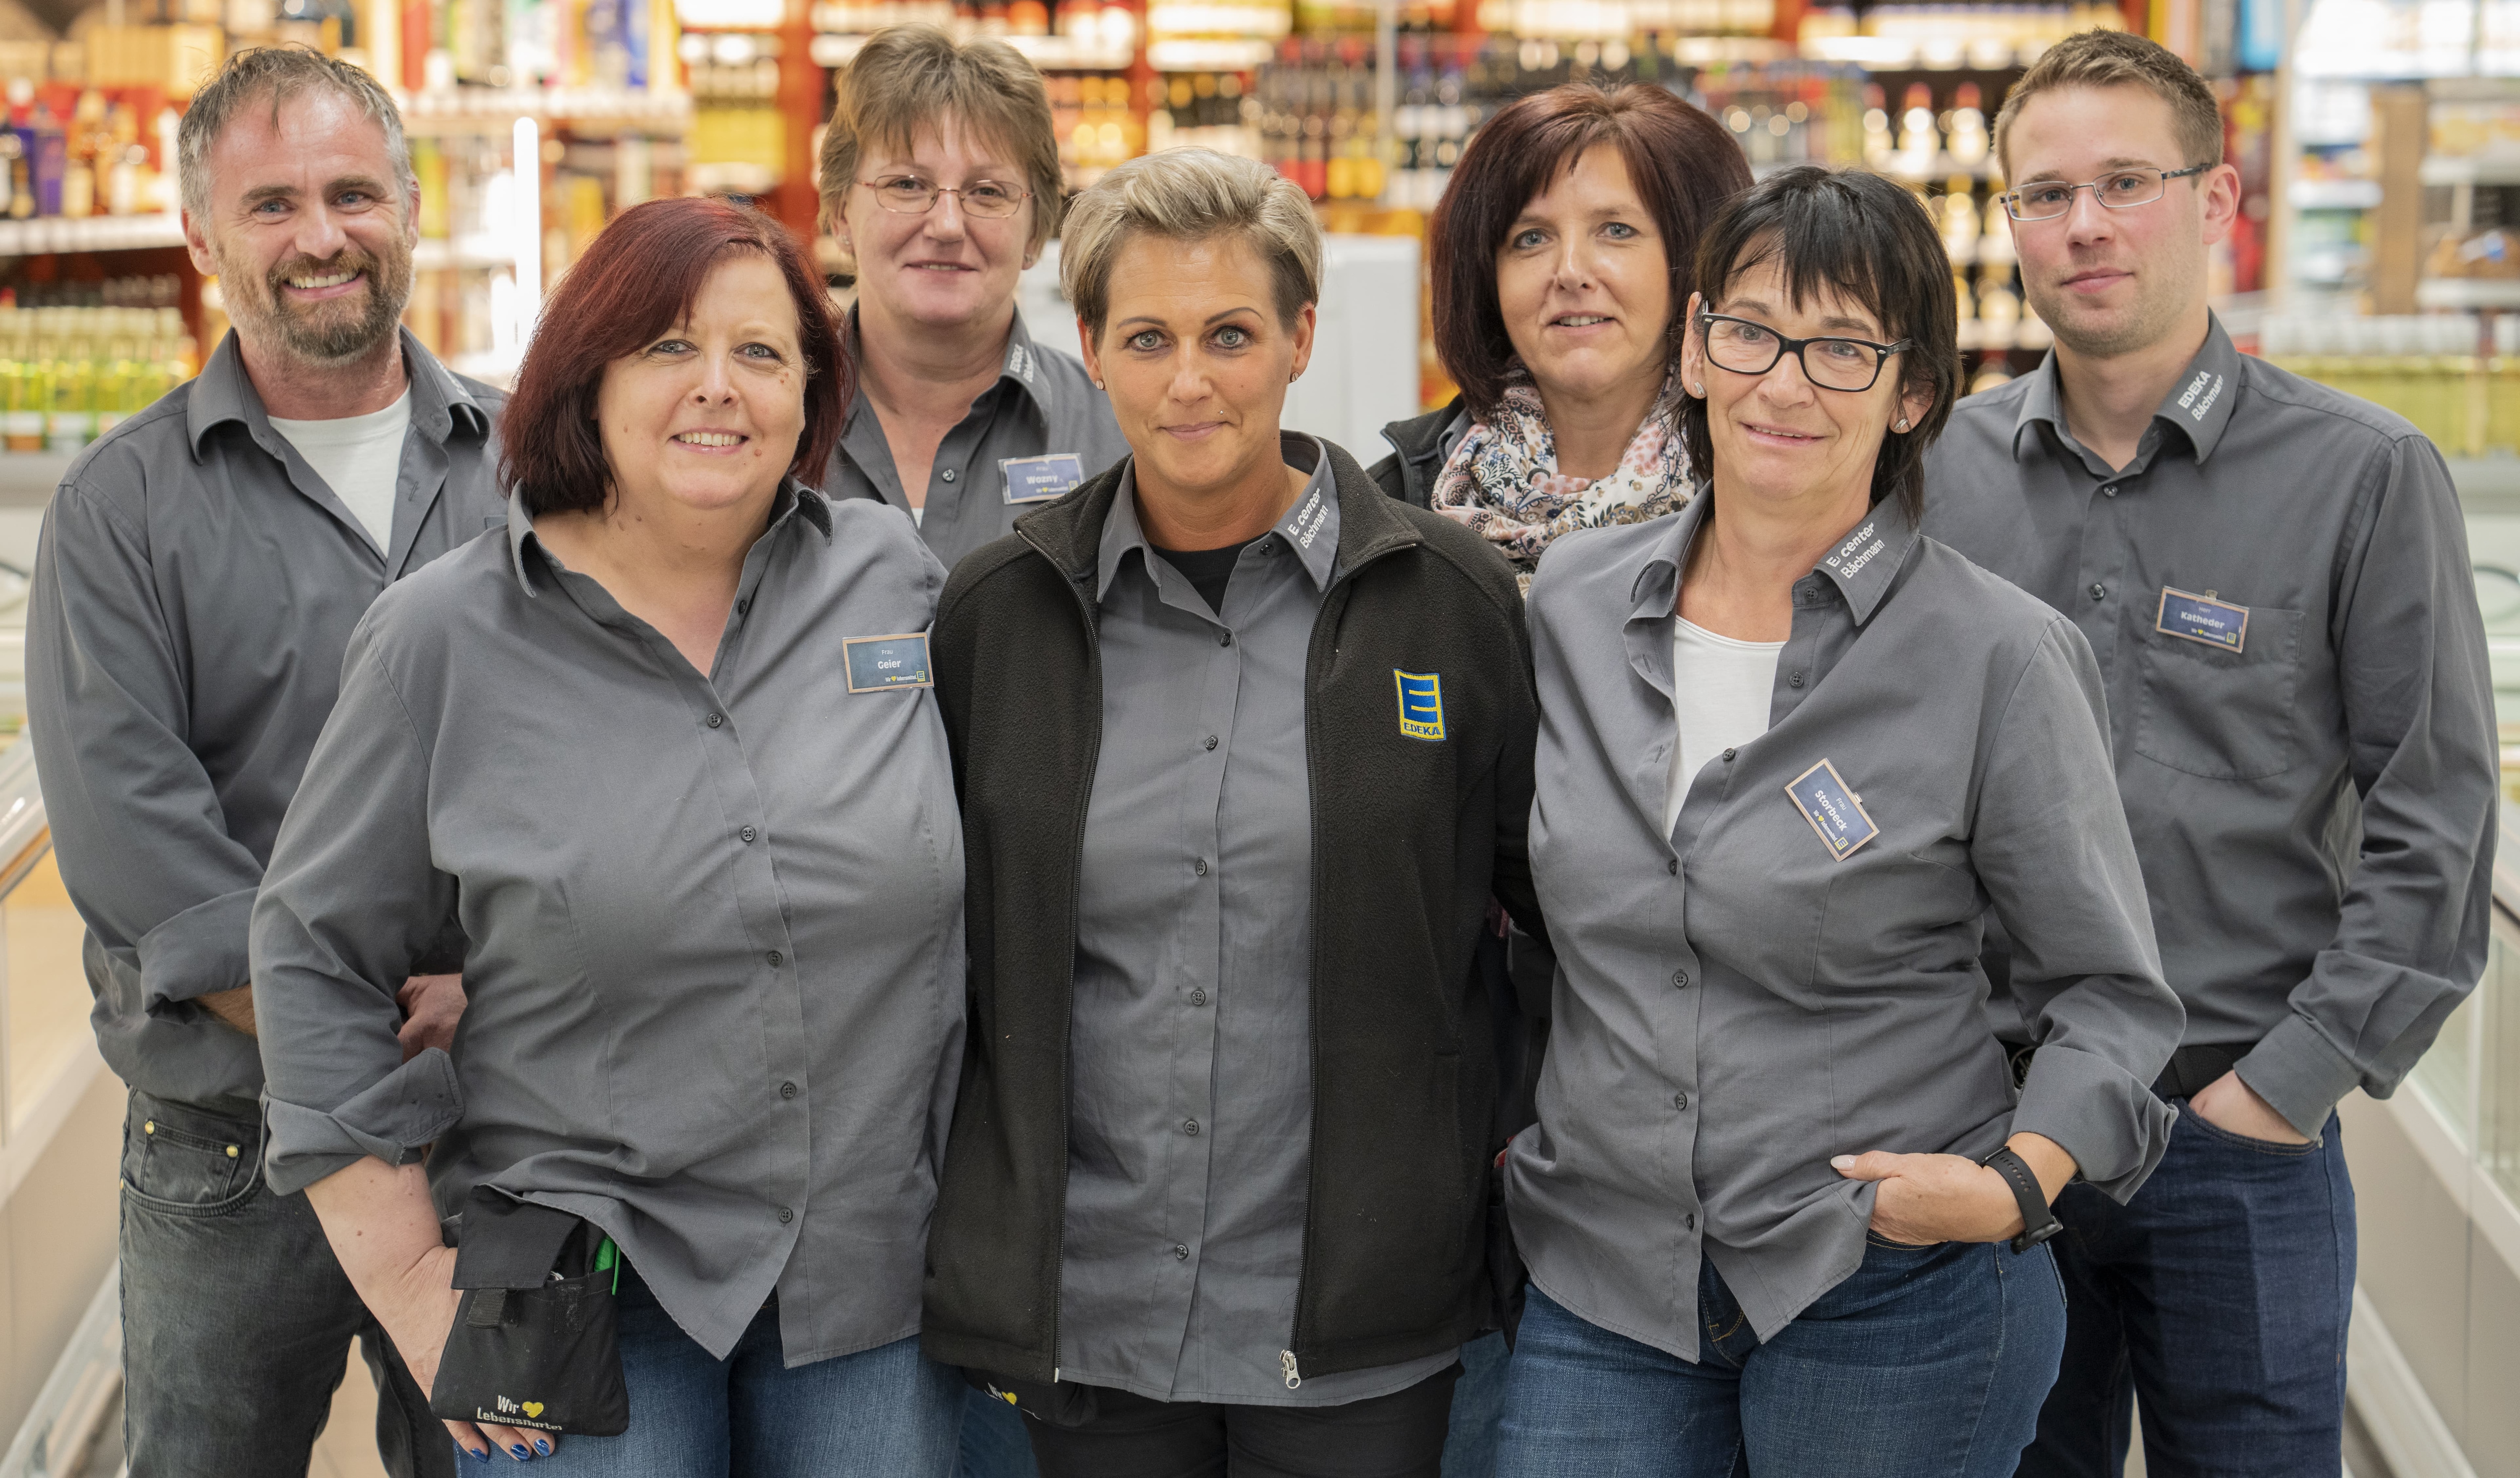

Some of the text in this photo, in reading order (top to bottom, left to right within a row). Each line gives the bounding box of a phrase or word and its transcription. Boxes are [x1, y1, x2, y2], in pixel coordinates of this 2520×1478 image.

[2177, 371, 2211, 409] EDEKA
[2191, 375, 2224, 421] Bächmann
[1026, 475, 1057, 484] Wozny
[1287, 487, 1320, 536] E center
[1299, 505, 1329, 549] Bächmann
[1841, 522, 1874, 557] center
[1840, 539, 1885, 579] Bächmann
[2181, 610, 2225, 629] Katheder
[877, 659, 901, 669] Geier
[1404, 722, 1441, 735] EDEKA
[1815, 790, 1847, 832] Storbeck
[1836, 797, 1847, 811] Frau
[497, 1394, 519, 1414] Wir
